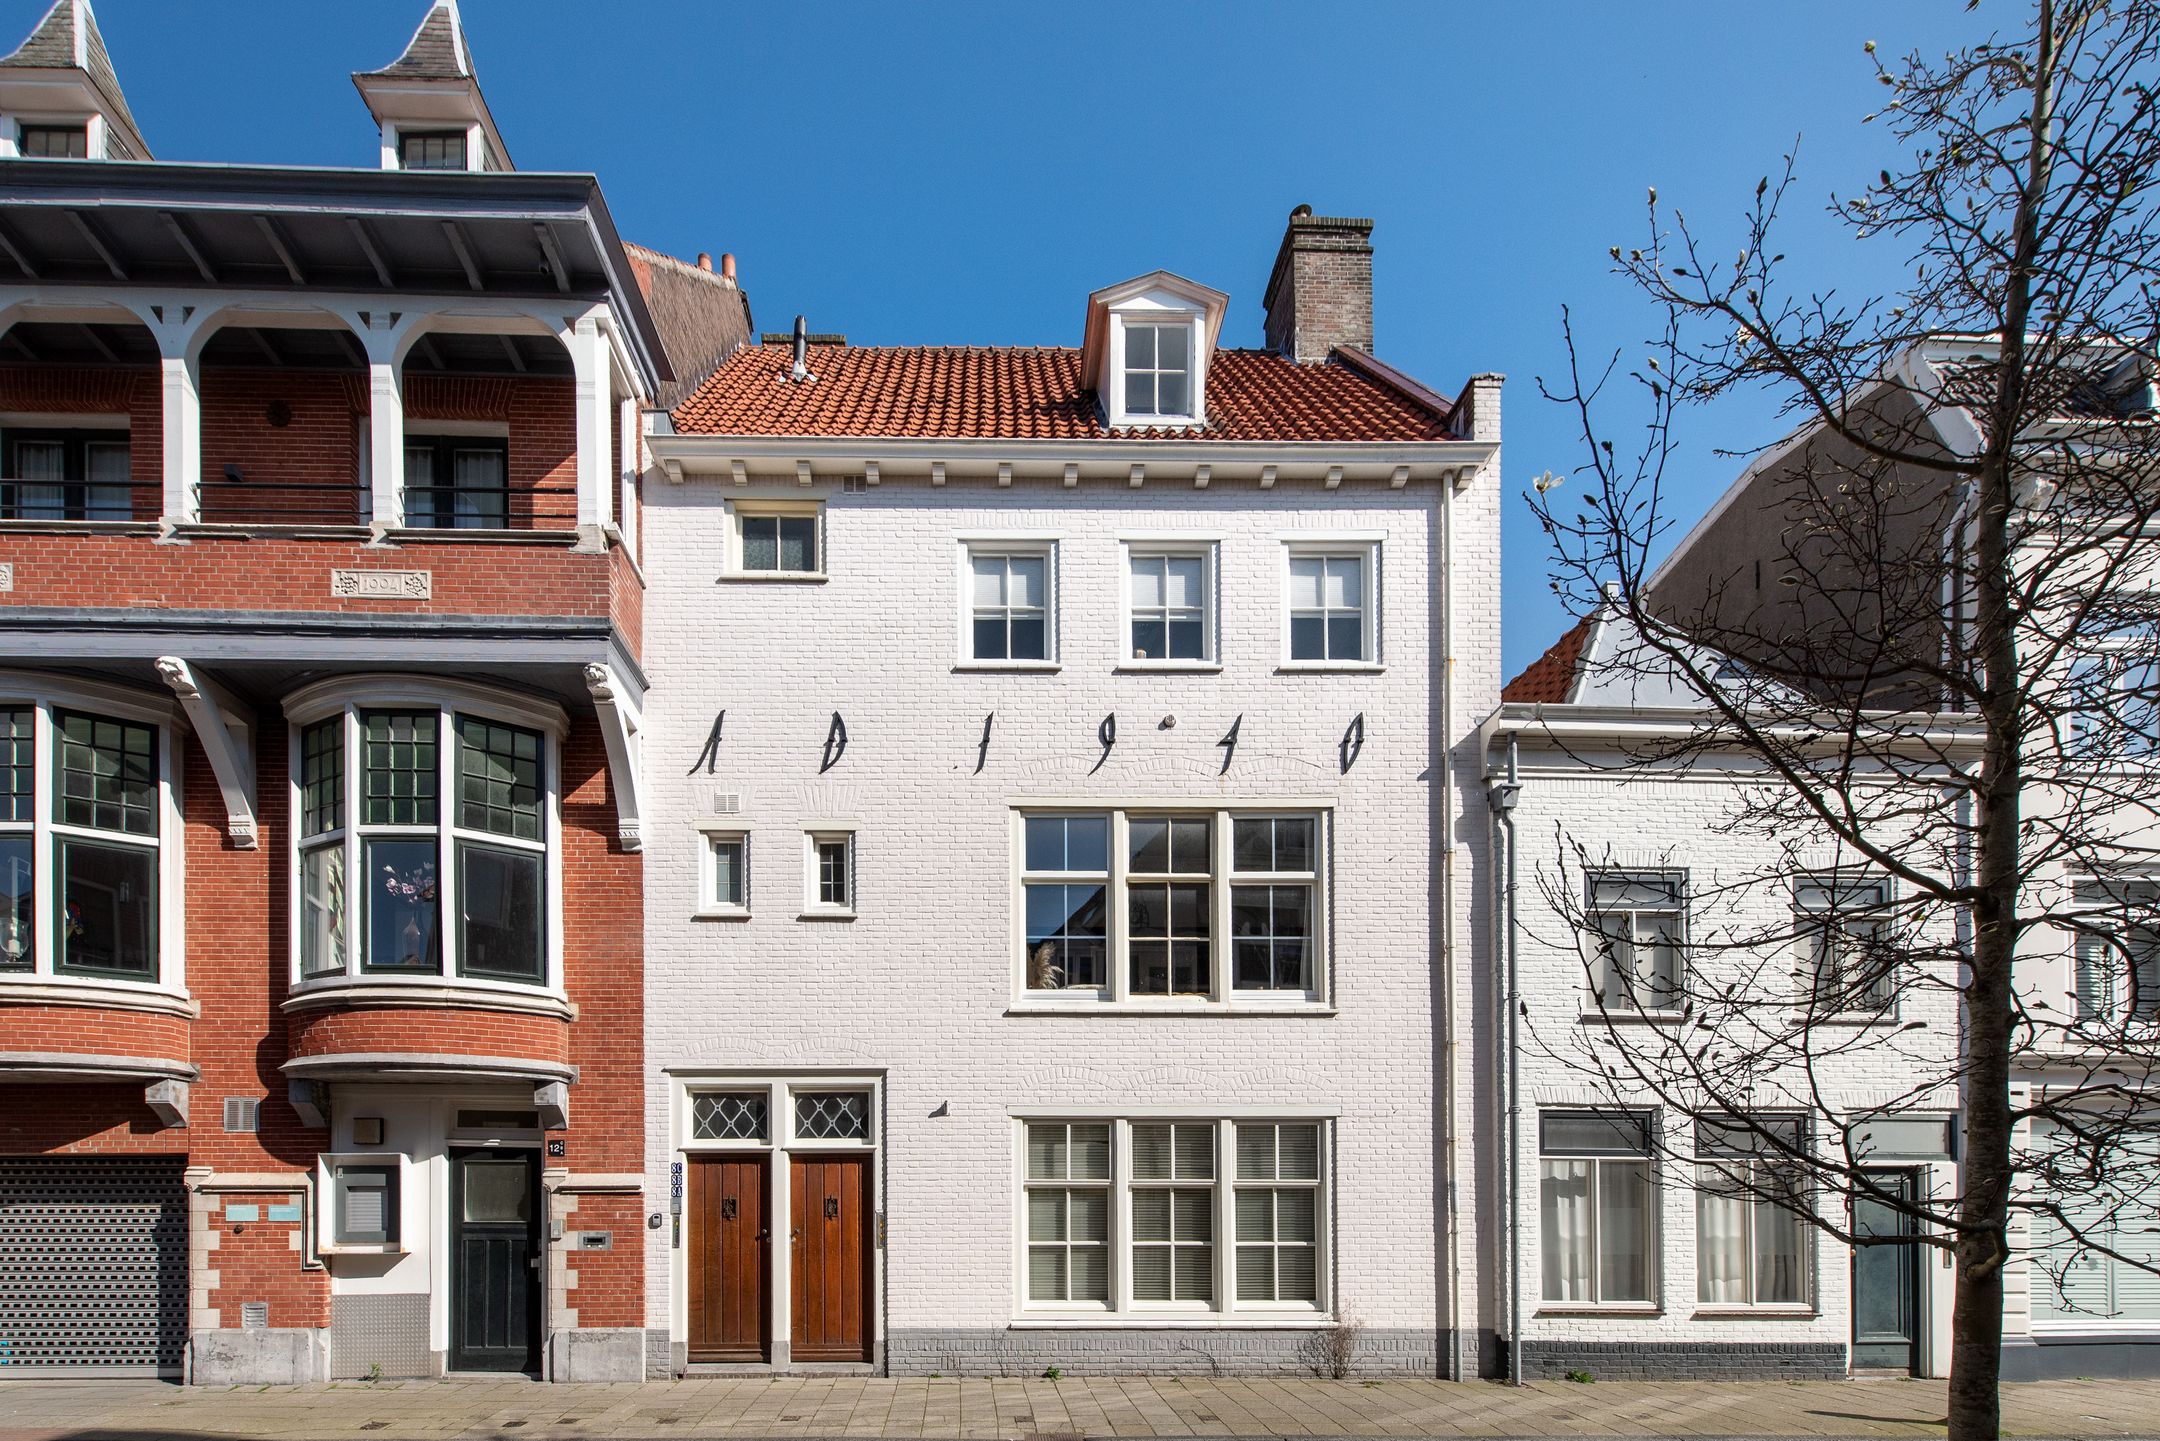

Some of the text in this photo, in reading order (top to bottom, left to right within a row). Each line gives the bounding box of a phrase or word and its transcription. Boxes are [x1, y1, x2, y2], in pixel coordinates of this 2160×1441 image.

[550, 1144, 560, 1152] 12
[671, 1163, 682, 1173] 8C
[671, 1175, 682, 1185] 8B
[671, 1187, 682, 1197] 8A
